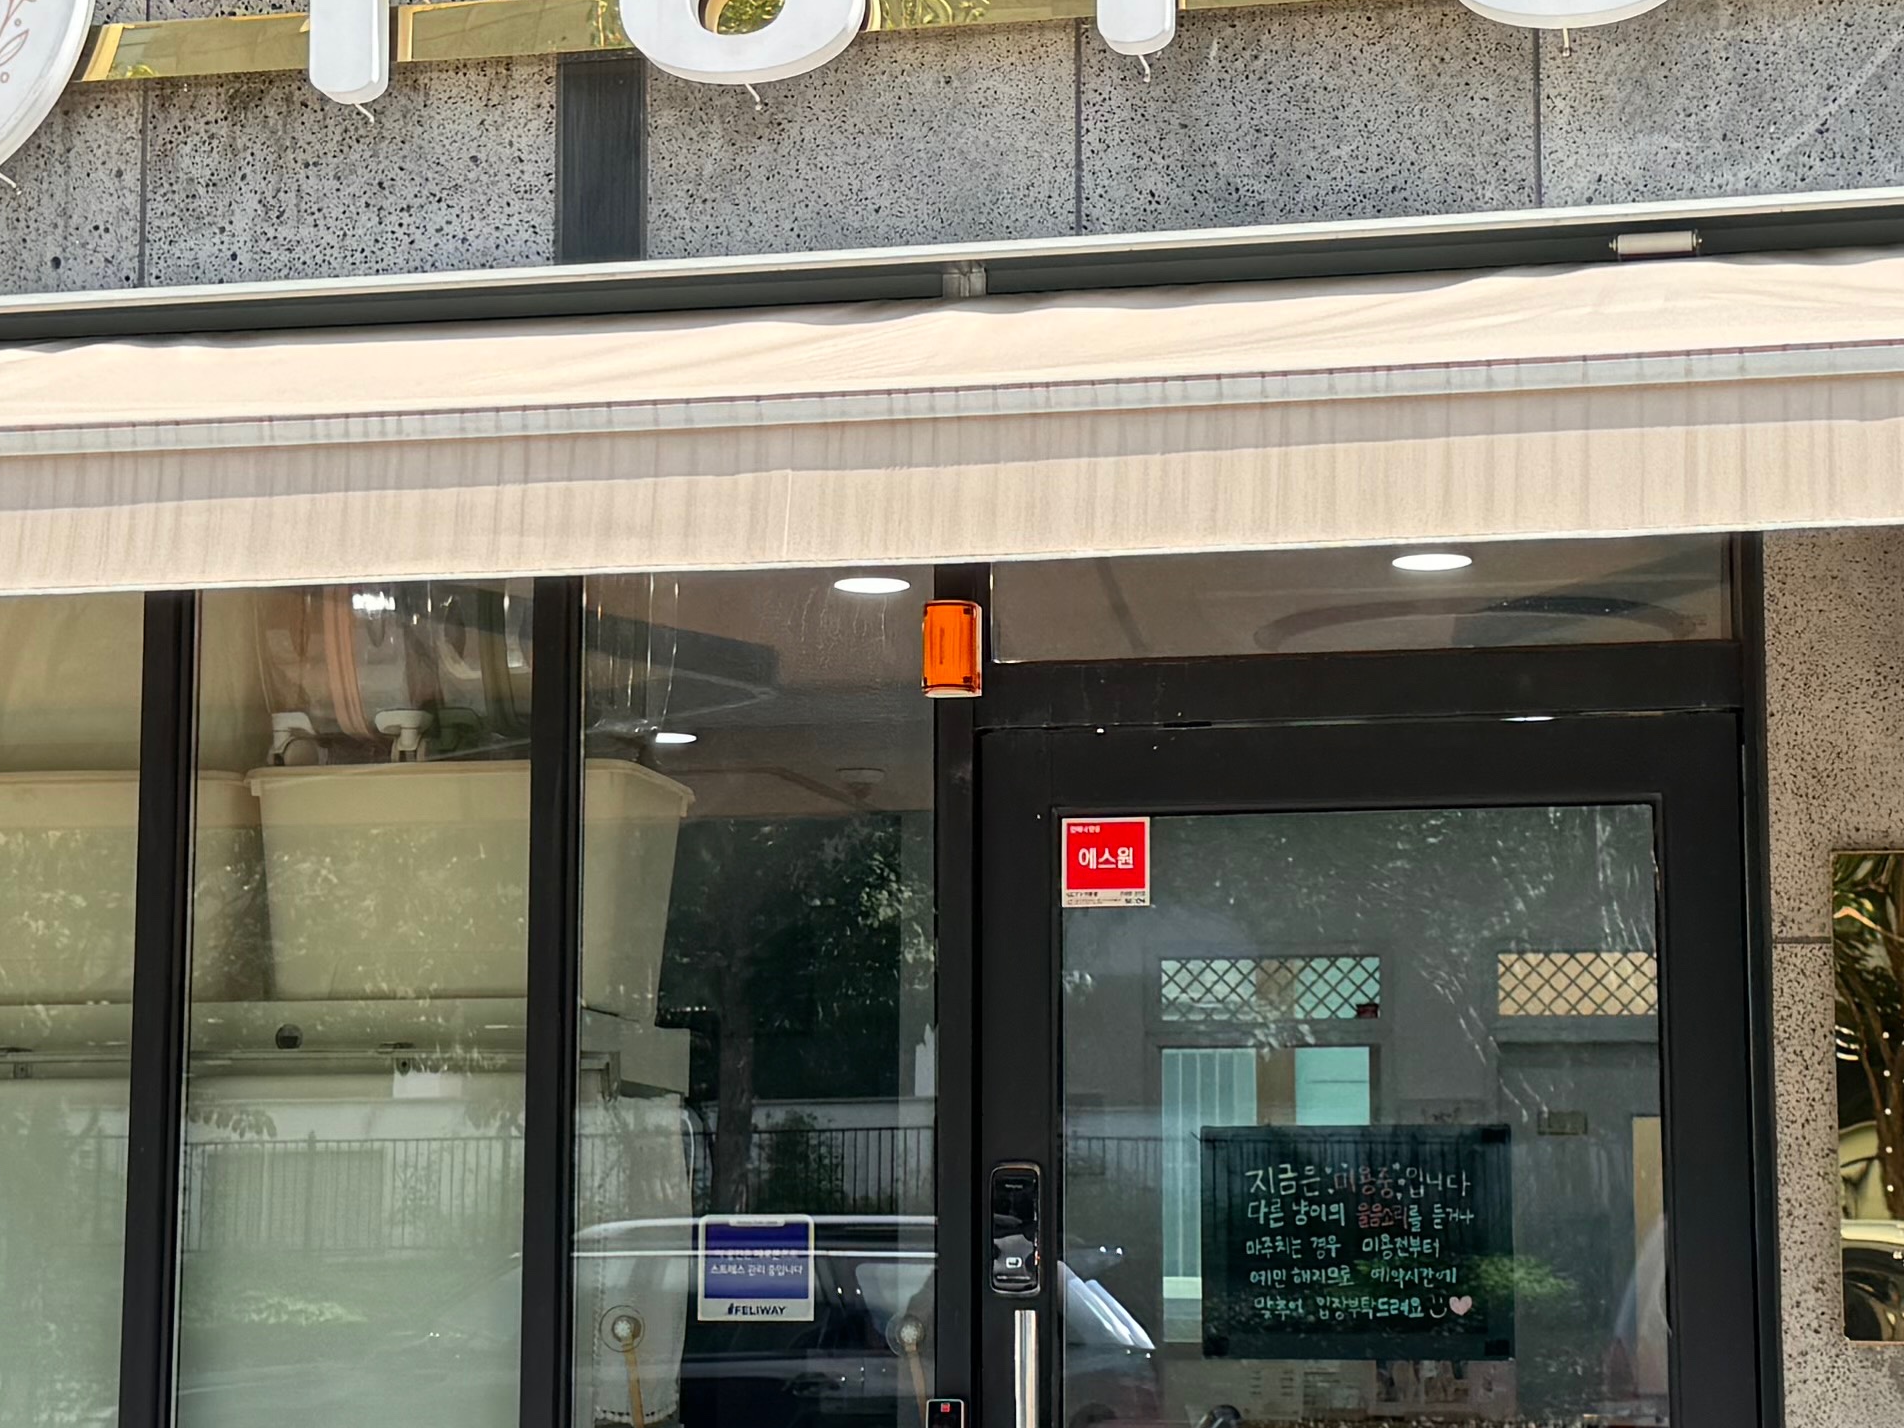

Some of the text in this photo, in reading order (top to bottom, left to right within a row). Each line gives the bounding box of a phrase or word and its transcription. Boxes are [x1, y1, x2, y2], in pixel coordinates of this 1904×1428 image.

[1078, 846, 1134, 869] 에스원
[1245, 1163, 1321, 1196] 지금은
[1248, 1198, 1284, 1228] 다른
[1292, 1198, 1345, 1227] 냥이의
[1432, 1203, 1475, 1230] 듣거나
[1246, 1233, 1440, 1260] 마주치는 경우 미용전부터
[1370, 1266, 1457, 1289] 예약시간에
[734, 1304, 786, 1316] FELIWAY
